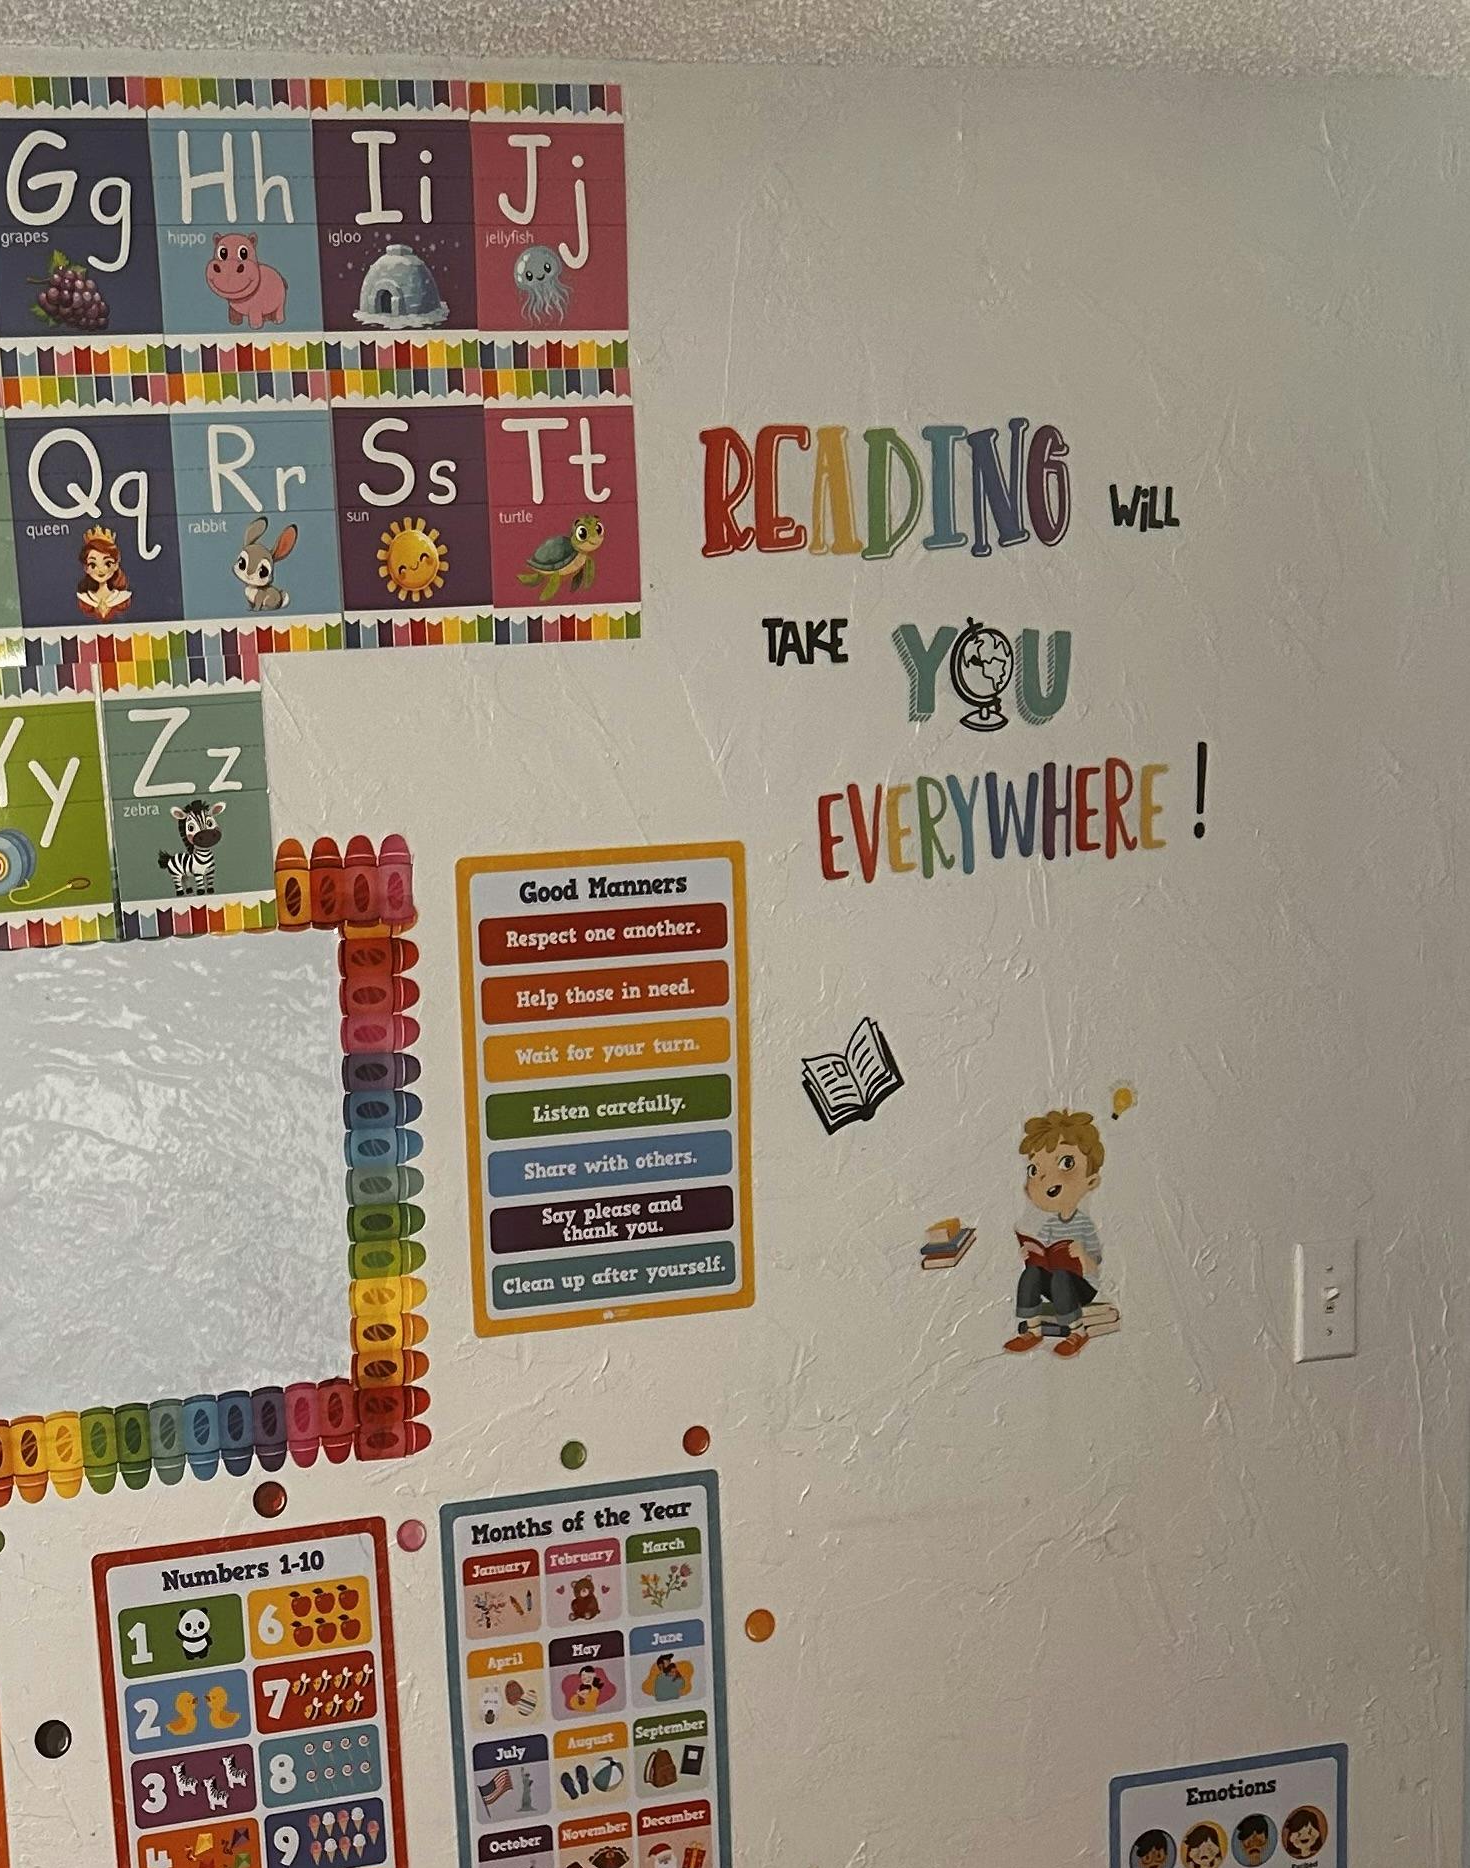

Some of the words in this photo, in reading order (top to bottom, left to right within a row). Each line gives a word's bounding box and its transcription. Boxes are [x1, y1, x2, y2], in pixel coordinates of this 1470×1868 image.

[177, 129, 294, 225] Hh
[351, 131, 434, 225] Ii
[5, 129, 133, 273] Gg
[498, 134, 587, 269] Jj
[0, 229, 50, 246] grapes
[167, 229, 207, 246] hippo
[327, 229, 362, 245] igloo
[208, 424, 307, 514] Rr
[357, 418, 458, 507] Ss
[501, 418, 613, 505] Tt
[27, 428, 162, 563] Qq
[699, 417, 1071, 560] READING
[25, 522, 69, 538] queen
[187, 518, 228, 535] rabbit
[346, 508, 370, 523] sun
[498, 508, 533, 524] turtle
[762, 618, 849, 665] TAKE
[127, 707, 242, 798] Zz
[123, 801, 160, 818] zebra
[519, 879, 579, 904] Good
[588, 873, 687, 900] Manners
[506, 928, 576, 950] Respect
[585, 922, 616, 942] one
[623, 919, 701, 939] another.
[533, 1103, 589, 1123] Listen
[597, 1094, 686, 1118] carefully.
[542, 1206, 575, 1226] Say
[583, 1200, 641, 1224] please
[648, 1196, 683, 1213] and
[563, 1224, 618, 1243] thank
[626, 1221, 663, 1240] you.
[503, 1275, 554, 1295] Clean
[561, 1273, 585, 1292] up
[593, 1265, 638, 1285] after
[646, 1256, 726, 1279] yourself.
[471, 1517, 553, 1545] Months
[563, 1510, 585, 1533] of
[595, 1504, 630, 1528] the
[640, 1500, 692, 1522] Year
[161, 1558, 269, 1591] Numbers
[280, 1550, 324, 1576] 1-10
[471, 1559, 531, 1579] January
[549, 1547, 614, 1568] February
[643, 1536, 685, 1554] March
[487, 1652, 523, 1671] April
[572, 1642, 601, 1658] May
[650, 1630, 684, 1644] June
[496, 1746, 526, 1762] July
[567, 1731, 614, 1749] August
[634, 1718, 706, 1739] September
[1186, 1777, 1276, 1806] Emotions
[489, 1834, 542, 1853] October
[562, 1821, 628, 1842] November
[642, 1808, 706, 1829] December
